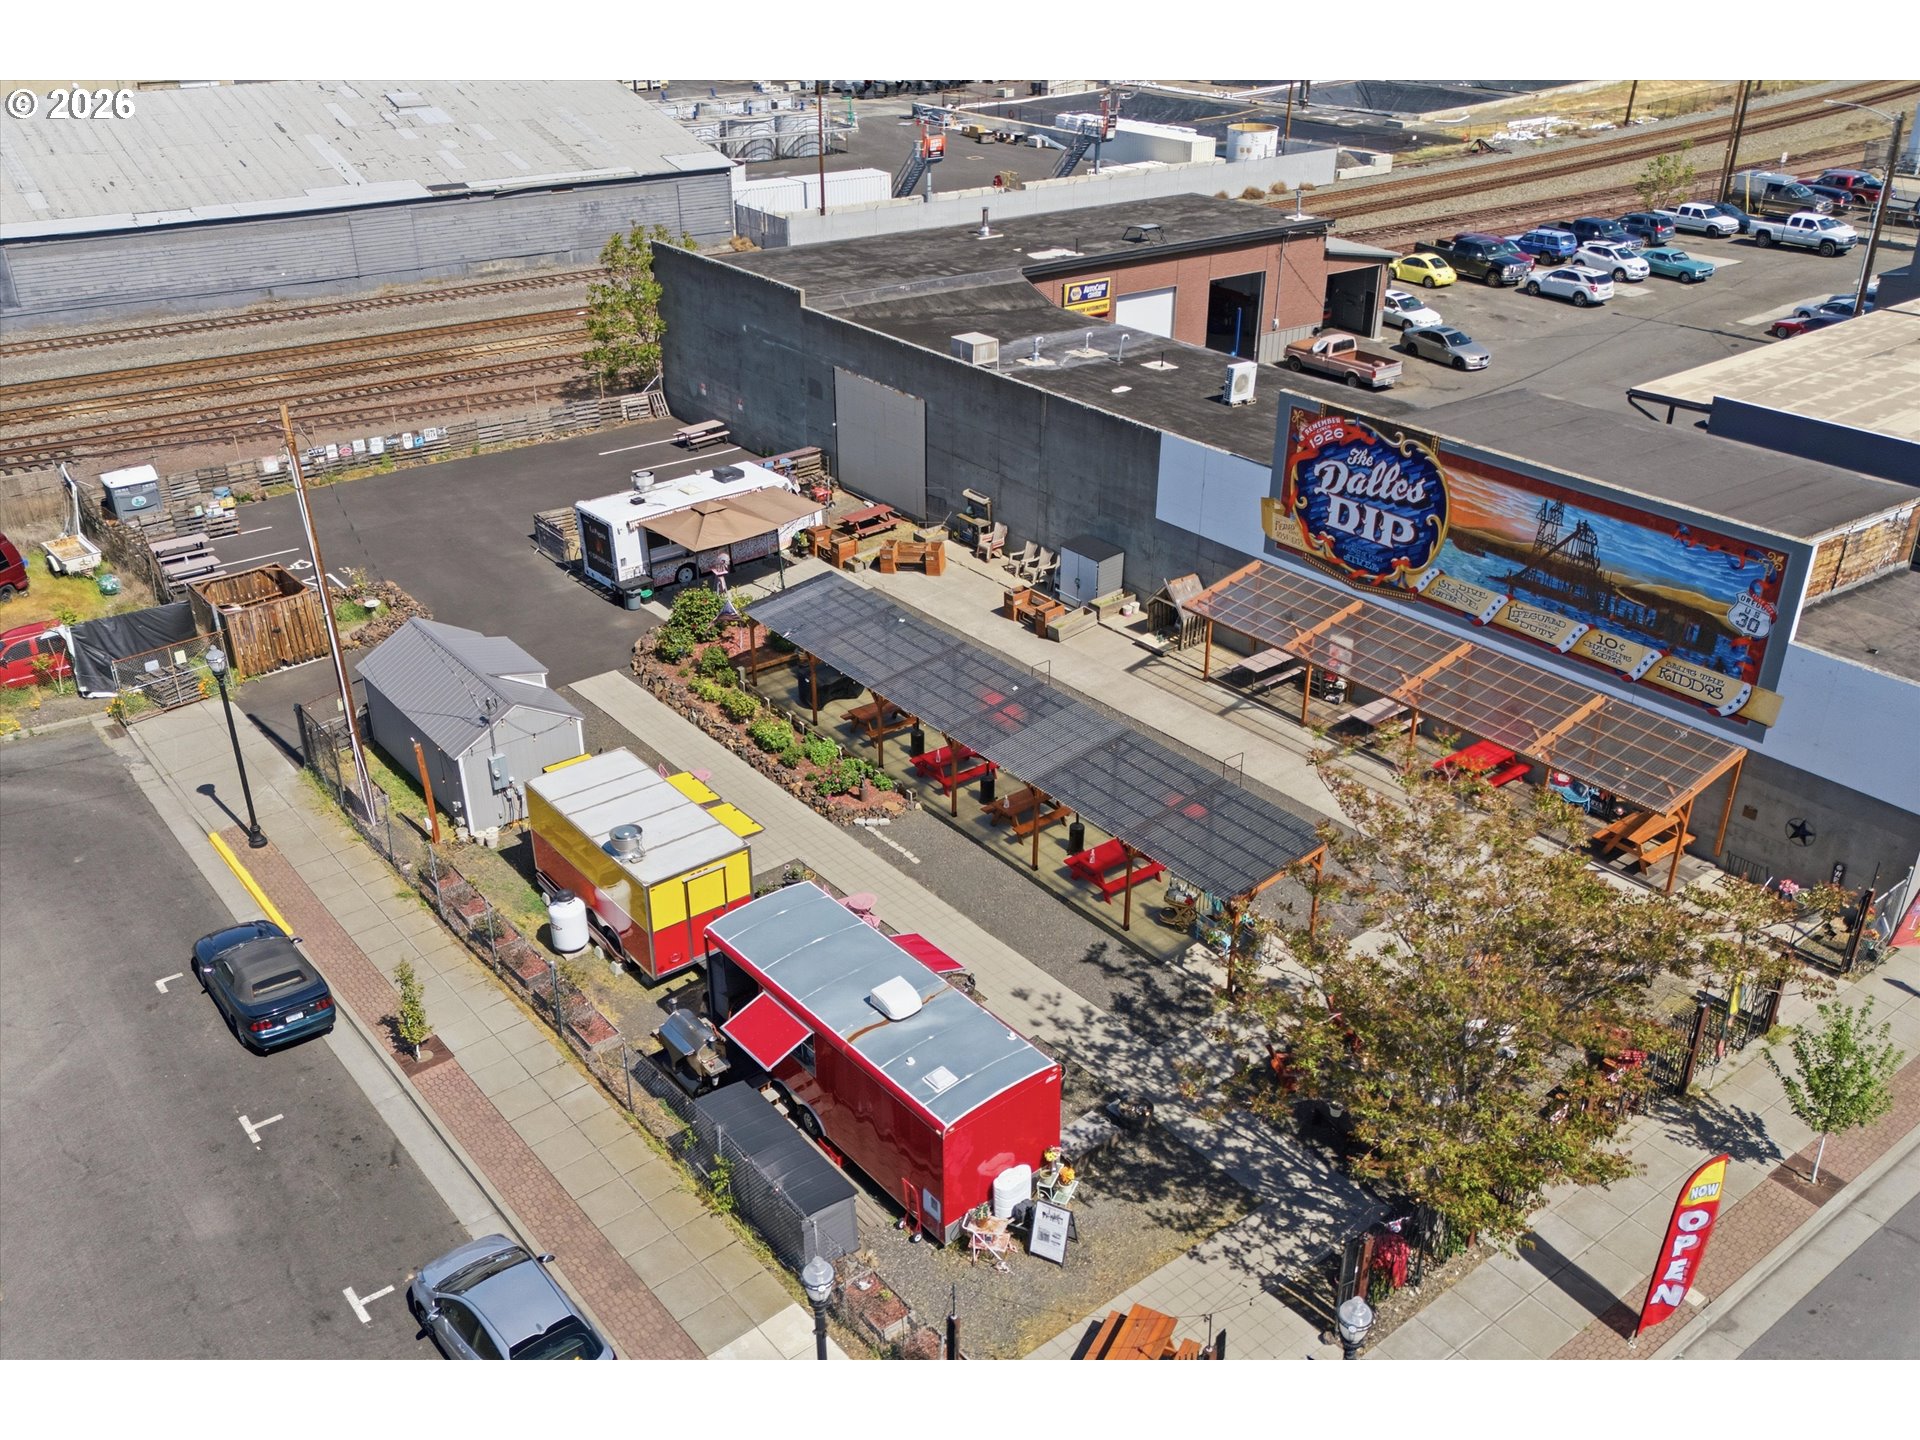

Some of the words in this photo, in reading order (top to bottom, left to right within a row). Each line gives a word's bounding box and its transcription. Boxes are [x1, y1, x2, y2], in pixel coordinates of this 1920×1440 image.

[1304, 417, 1341, 436] REMEMBER
[1309, 427, 1344, 449] 1926
[1347, 448, 1375, 468] The
[1314, 460, 1426, 503] Dalles
[1325, 493, 1416, 548] DIP
[1458, 583, 1488, 600] DIVE
[1519, 620, 1557, 639] DUTY
[1735, 611, 1761, 634] 30
[1656, 665, 1724, 700] KIDDOS
[1699, 673, 1725, 688] THE
[1689, 1182, 1720, 1201] NOW
[1649, 1208, 1712, 1308] OPEN
